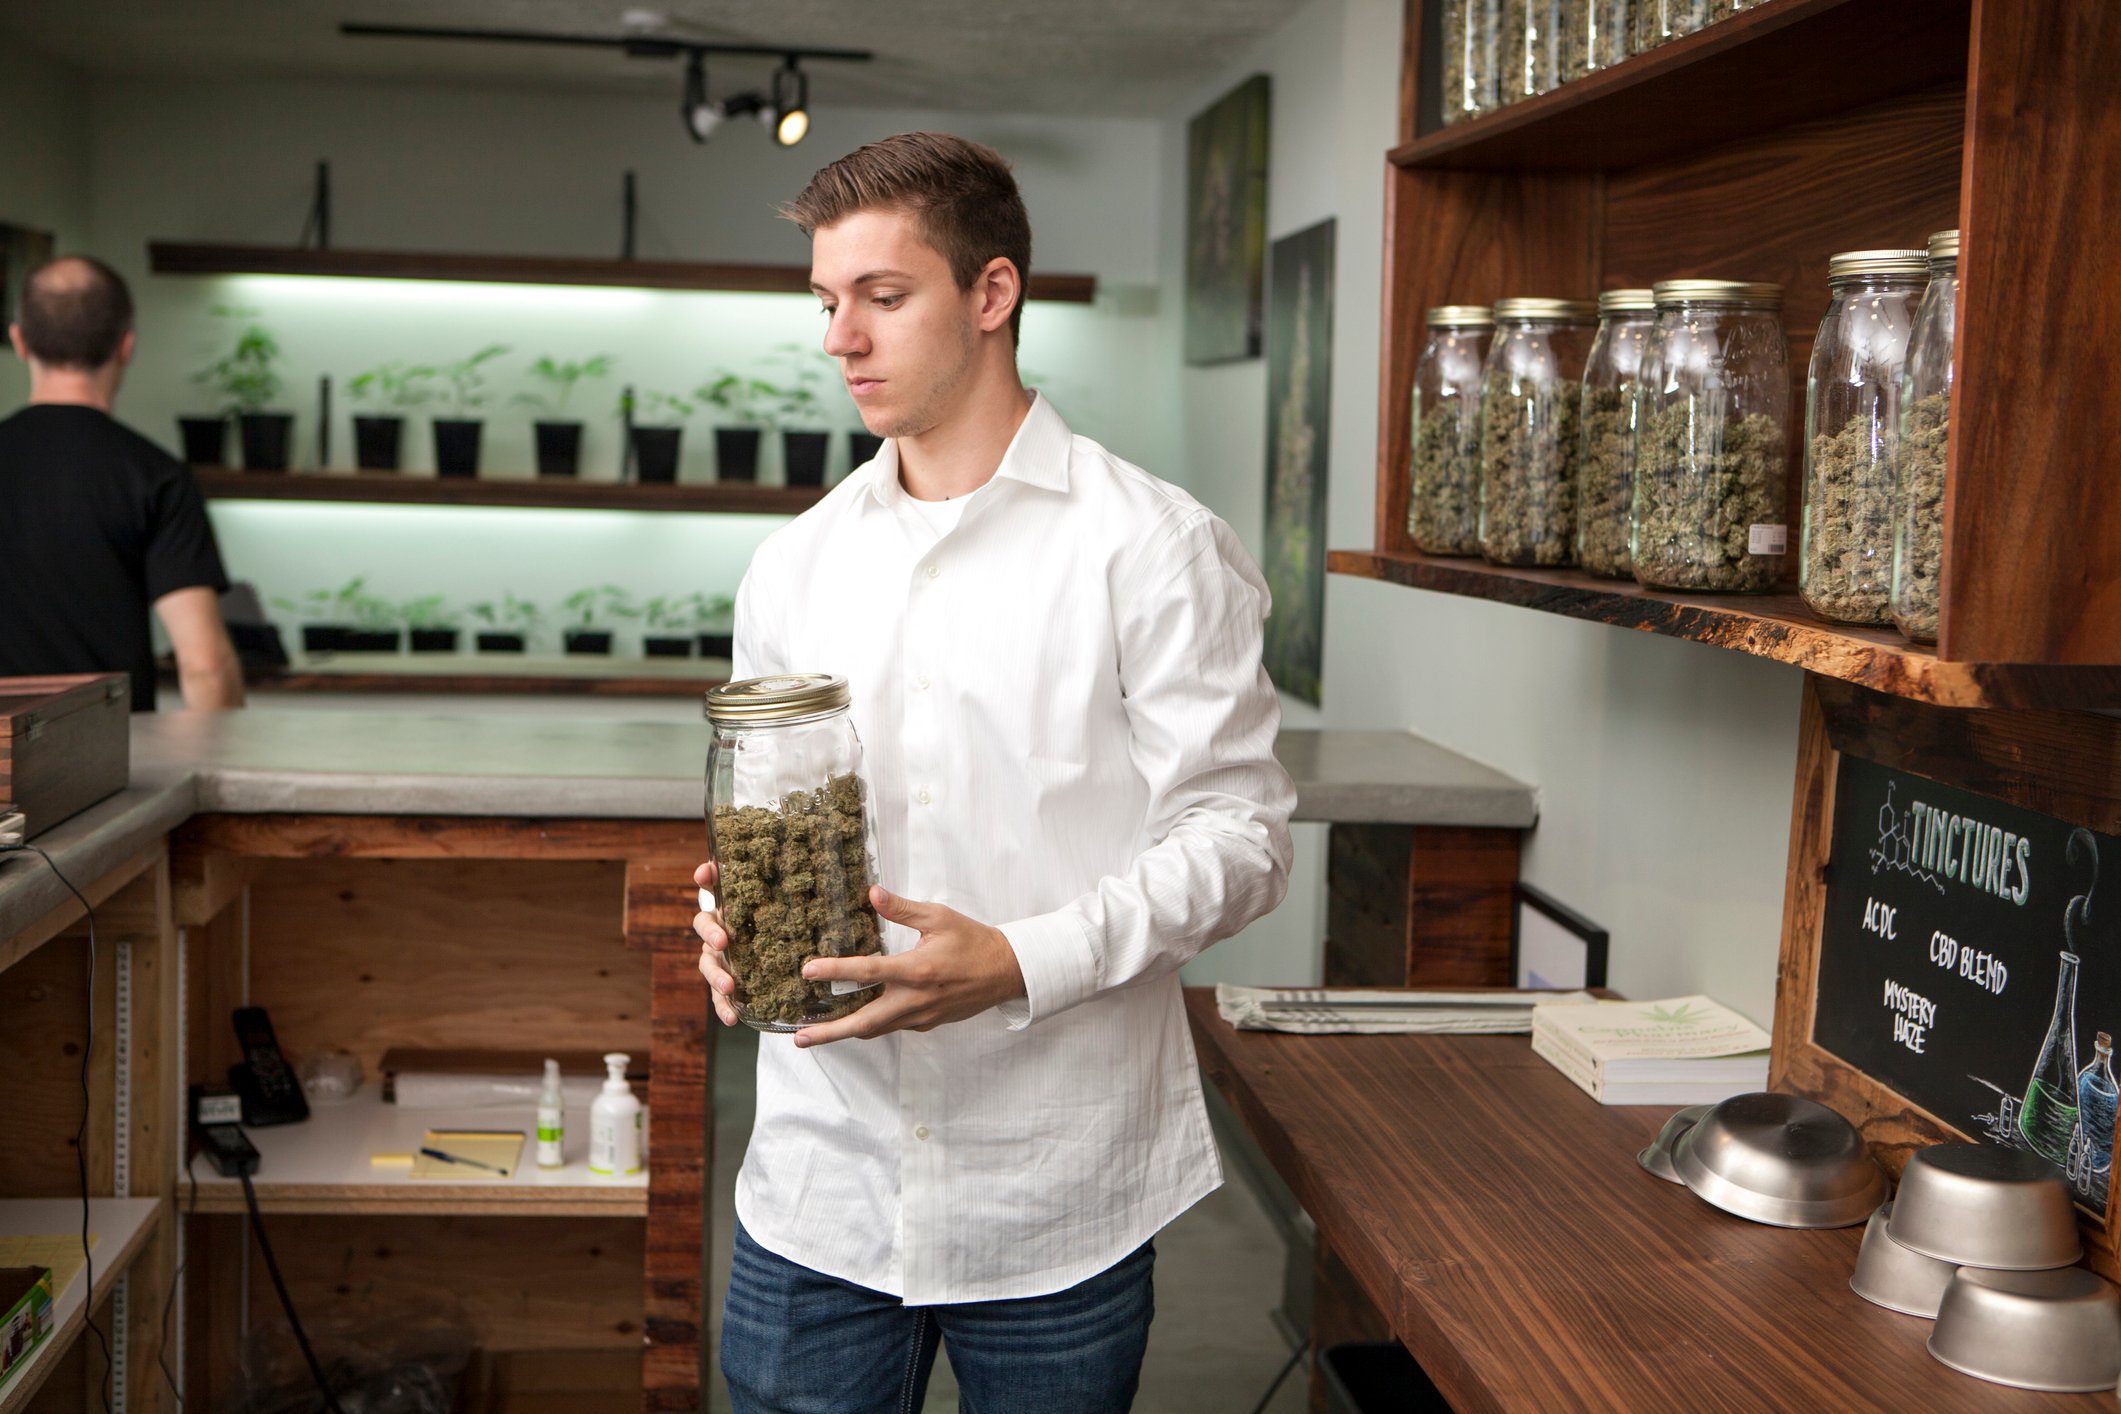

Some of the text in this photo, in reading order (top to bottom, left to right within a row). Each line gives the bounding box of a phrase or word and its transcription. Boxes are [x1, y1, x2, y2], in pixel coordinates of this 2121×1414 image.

[1911, 800, 2031, 906] TINCTURES
[1862, 896, 1897, 941] ACDC
[1930, 930, 2008, 996] CBD BLEND
[1883, 977, 1937, 1030] MYSTERY
[1893, 1012, 1926, 1054] HAZE
